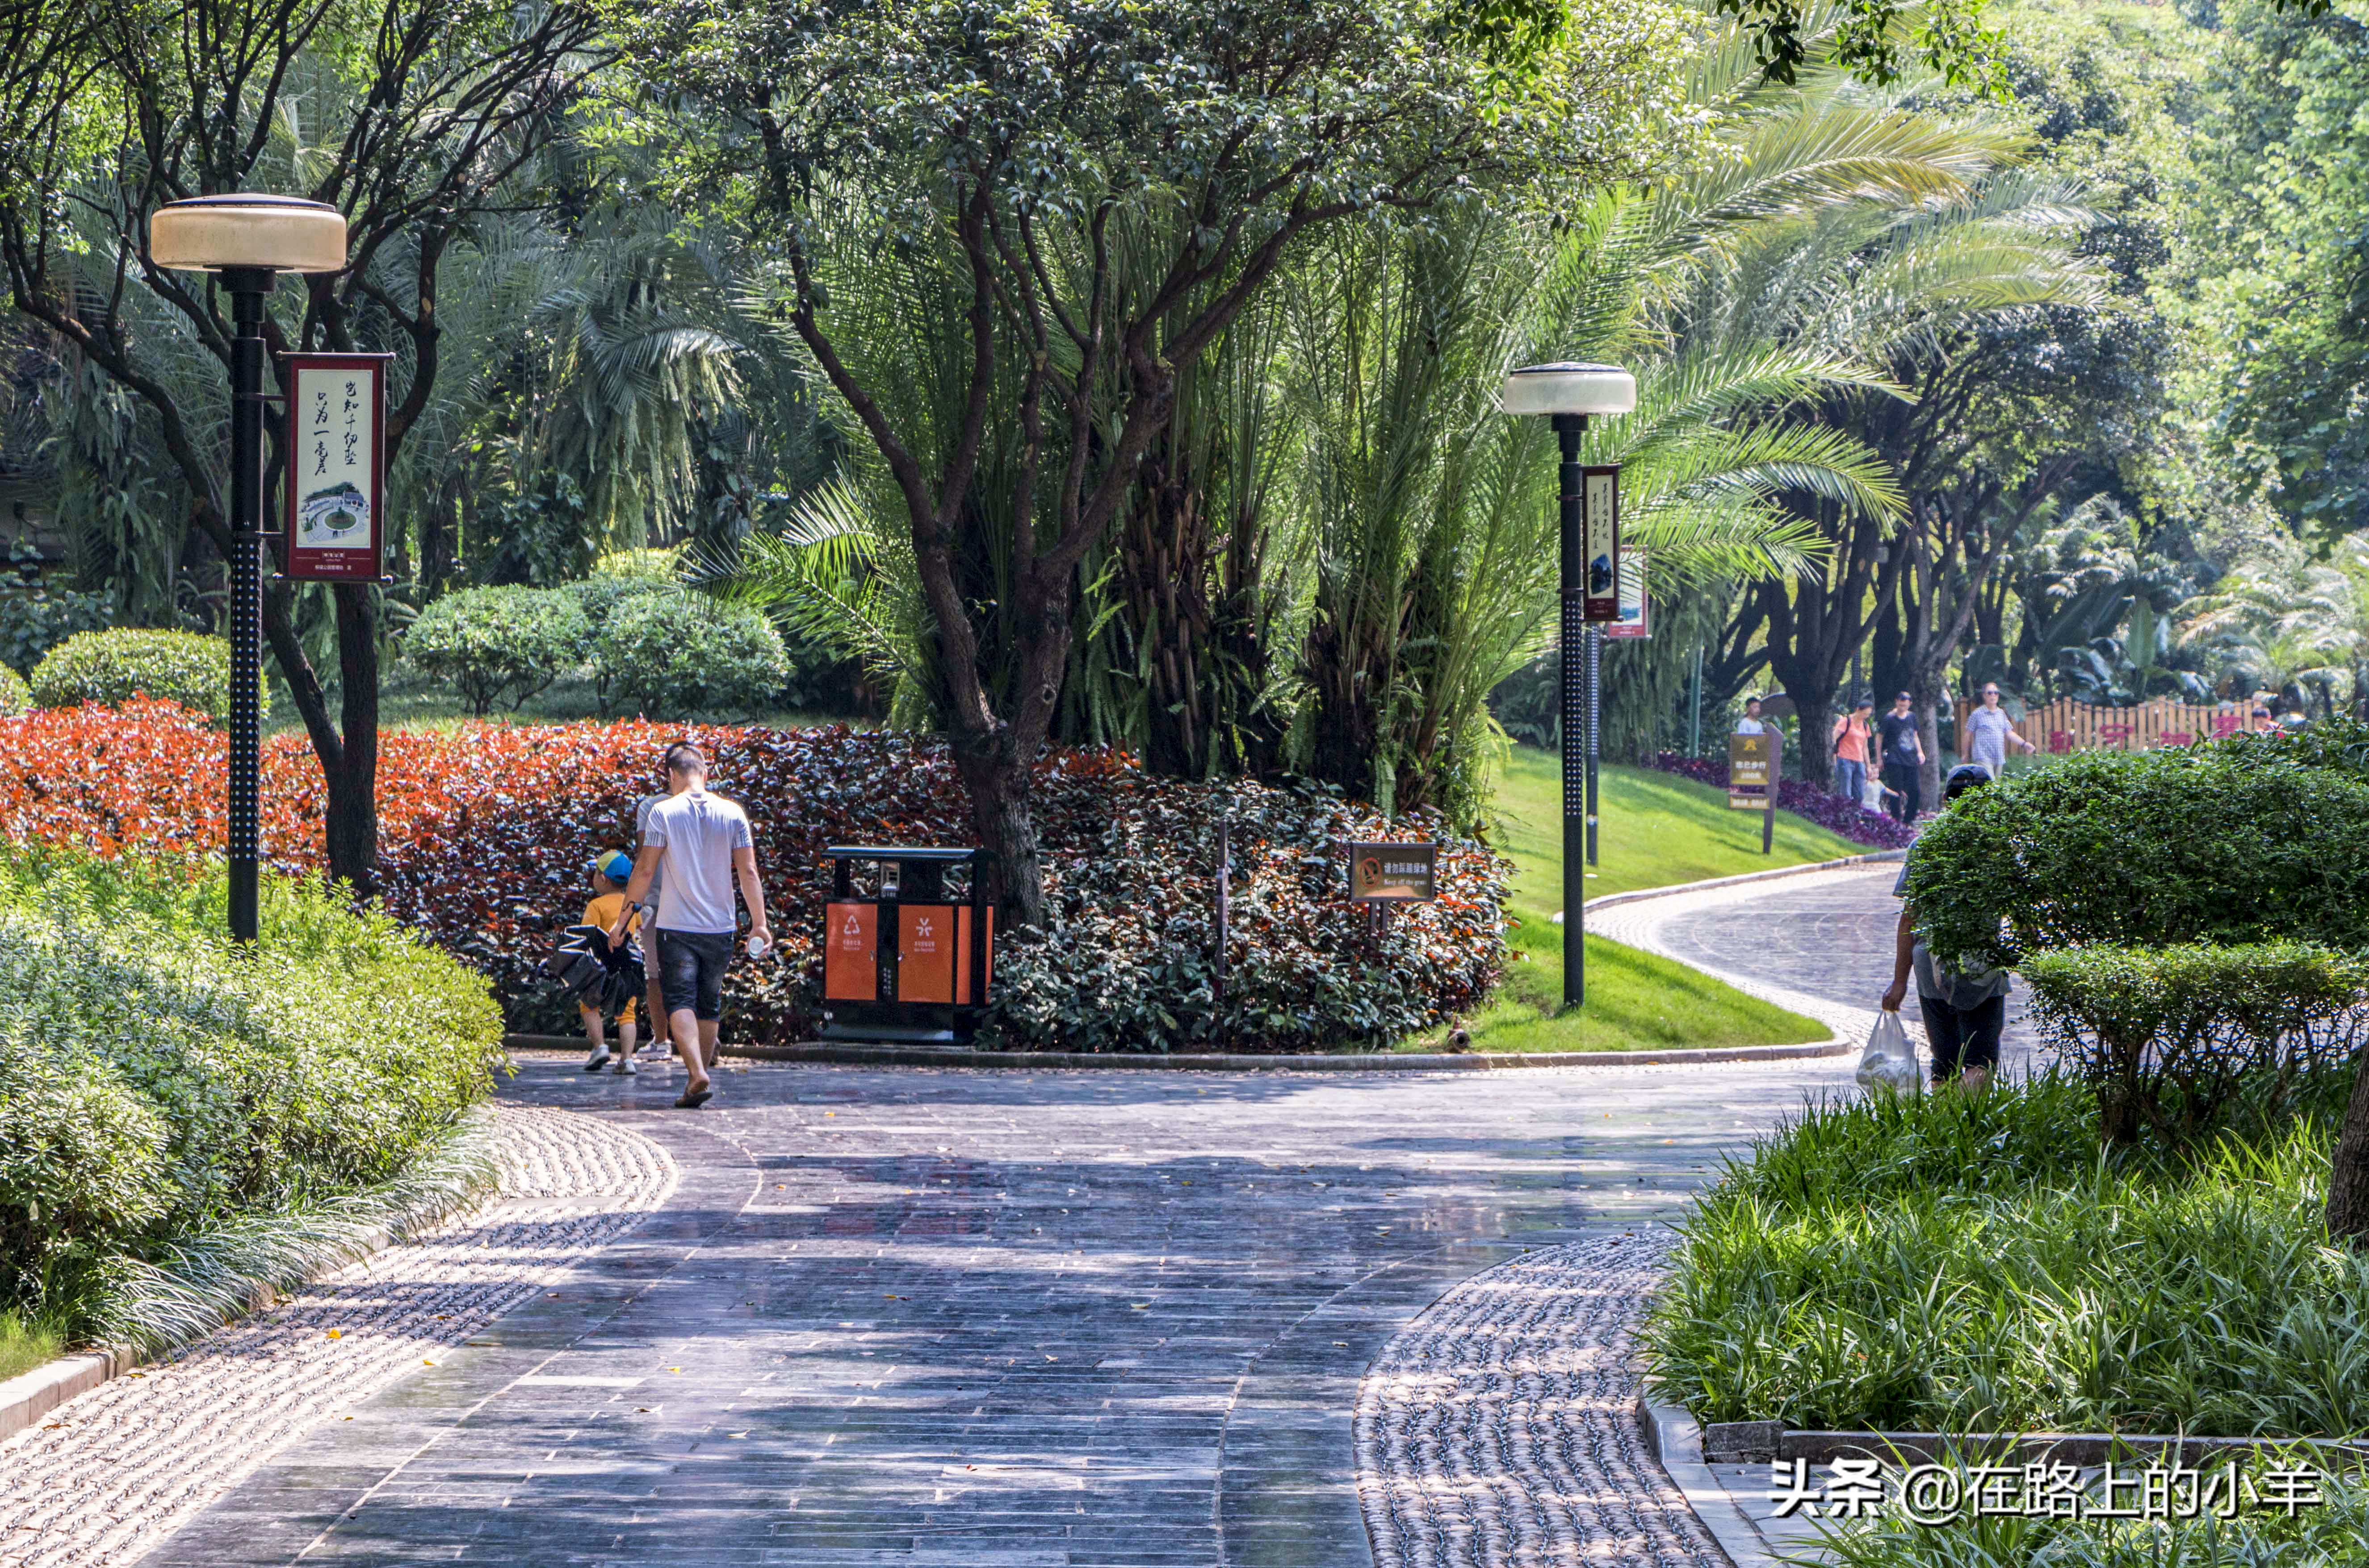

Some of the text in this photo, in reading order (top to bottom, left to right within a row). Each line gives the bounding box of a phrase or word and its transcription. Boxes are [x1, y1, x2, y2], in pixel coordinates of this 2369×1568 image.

[314, 392, 330, 476] 只为一毫差
[344, 381, 359, 465] 岂知千仞坠
